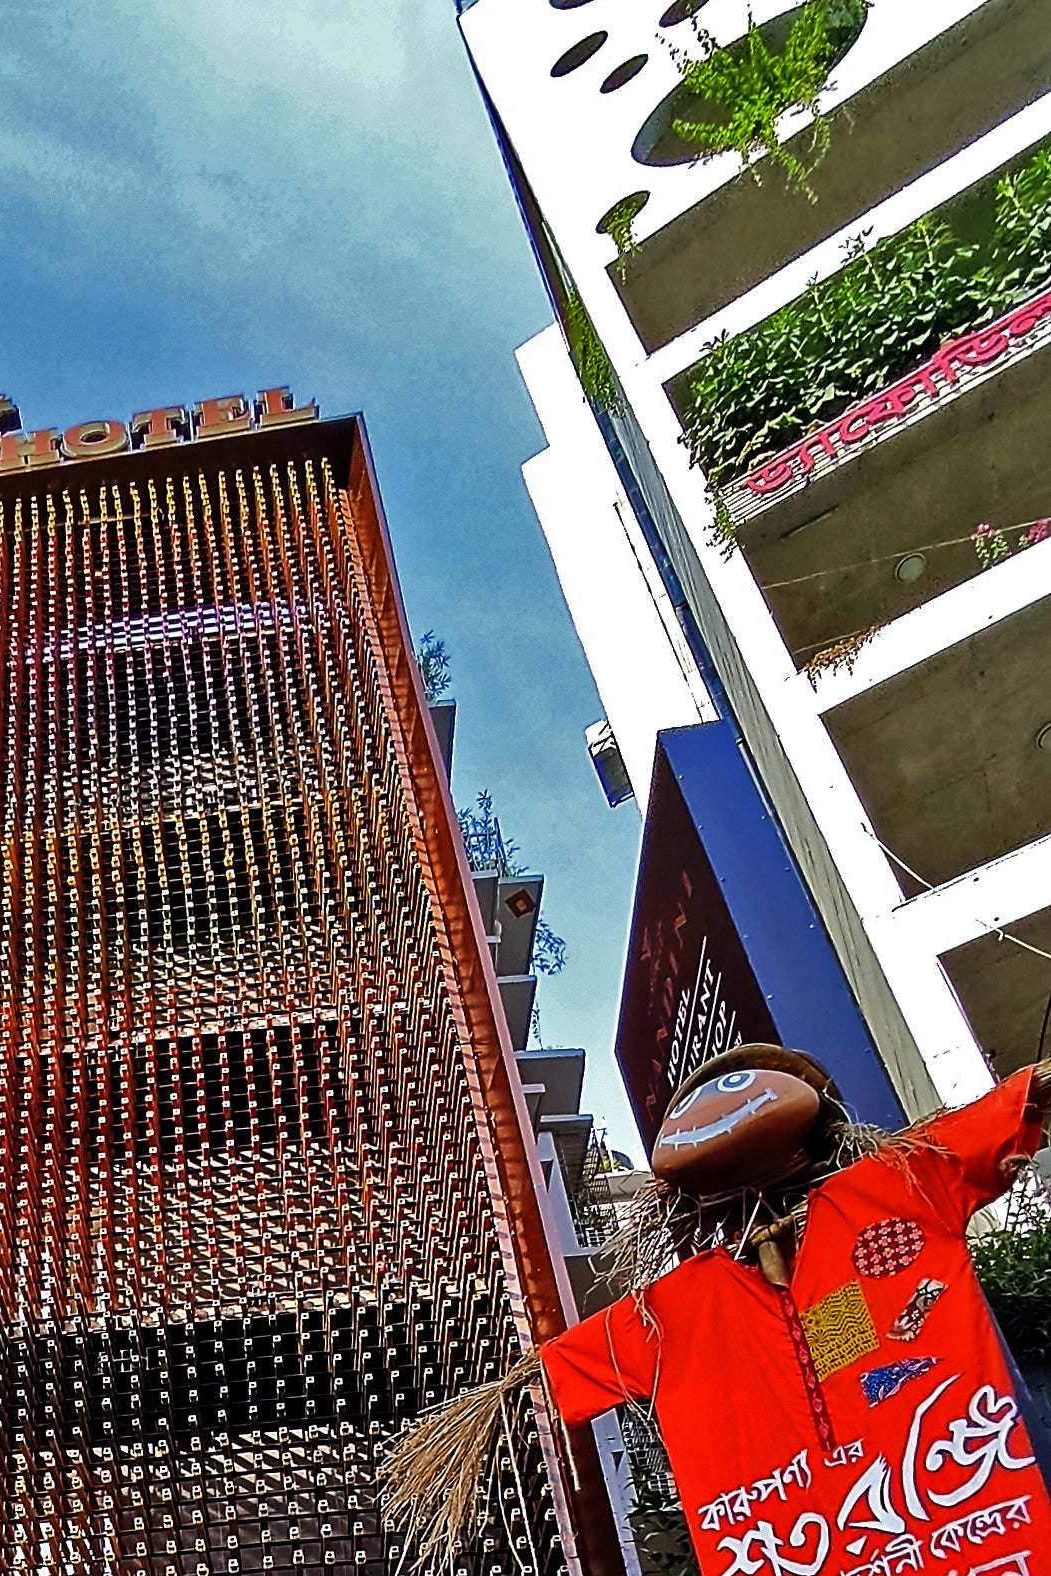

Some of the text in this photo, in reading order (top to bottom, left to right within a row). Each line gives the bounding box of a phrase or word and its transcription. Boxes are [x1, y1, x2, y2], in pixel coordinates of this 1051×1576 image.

[667, 987, 691, 1088] HOTEL
[698, 1439, 867, 1531] কারুপণ্য এর
[931, 1496, 1032, 1559] কেন্দ্রের
